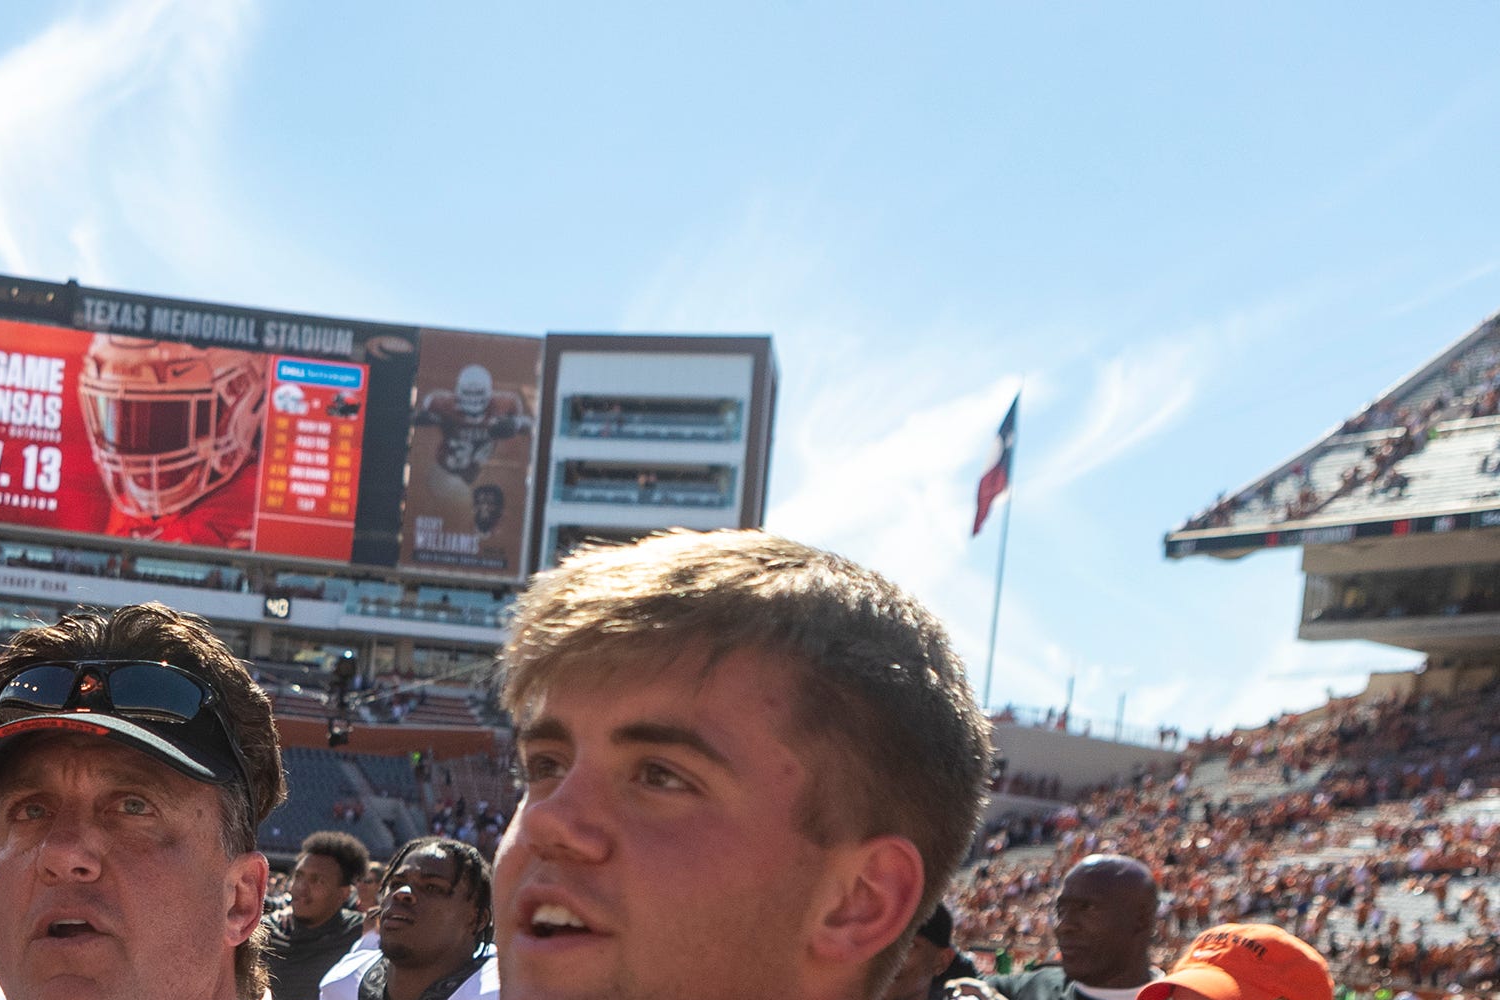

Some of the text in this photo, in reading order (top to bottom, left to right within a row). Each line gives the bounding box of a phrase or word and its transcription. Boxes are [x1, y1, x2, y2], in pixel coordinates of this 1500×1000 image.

[84, 298, 354, 354] TEXAS MEMORIAL STADIUM
[22, 444, 63, 493] 13
